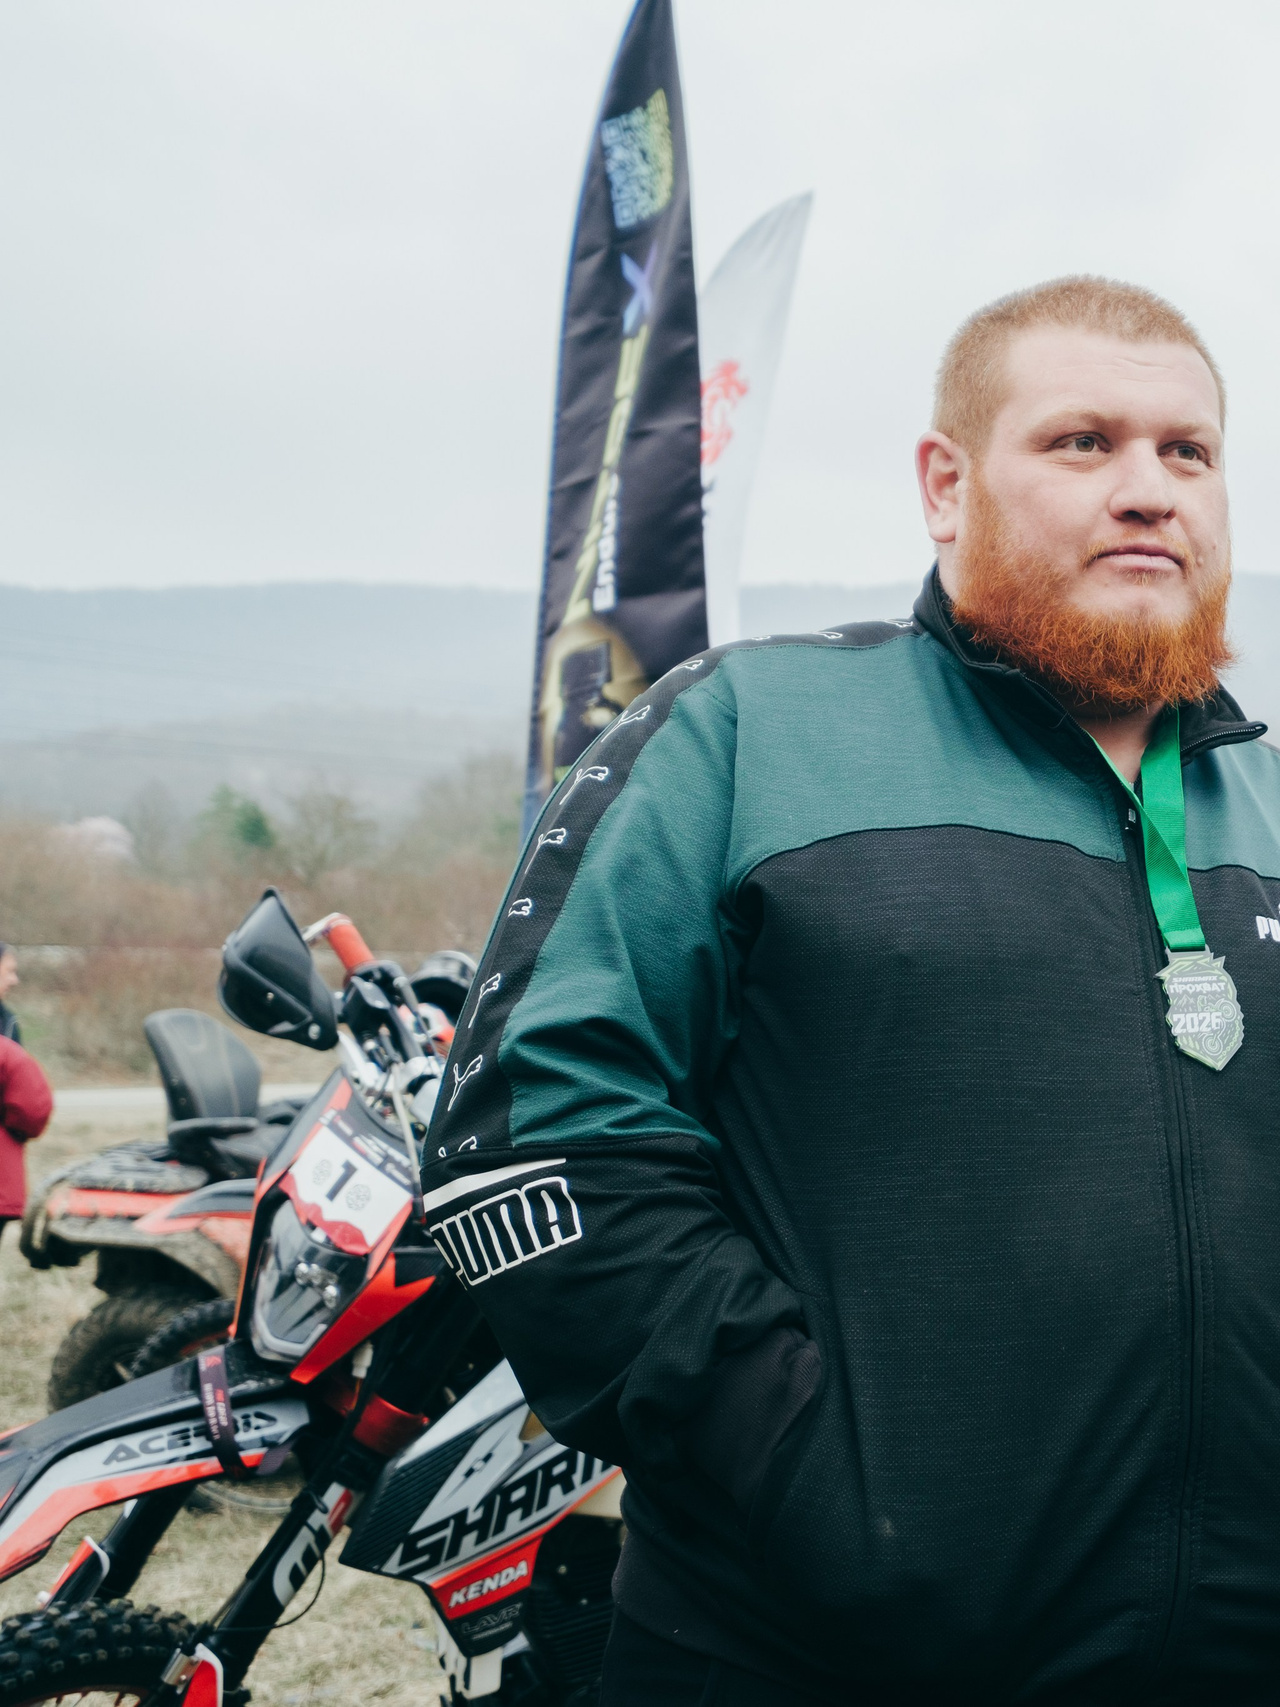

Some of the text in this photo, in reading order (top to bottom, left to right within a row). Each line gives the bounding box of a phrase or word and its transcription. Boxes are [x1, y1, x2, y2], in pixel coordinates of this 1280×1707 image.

[1169, 982, 1226, 994] ПРОХВАТ
[1172, 1011, 1222, 1034] 2026
[325, 1159, 358, 1202] 1
[429, 1176, 582, 1291] PUMA
[102, 1410, 278, 1466] ACERIS
[449, 1559, 529, 1608] KENDA
